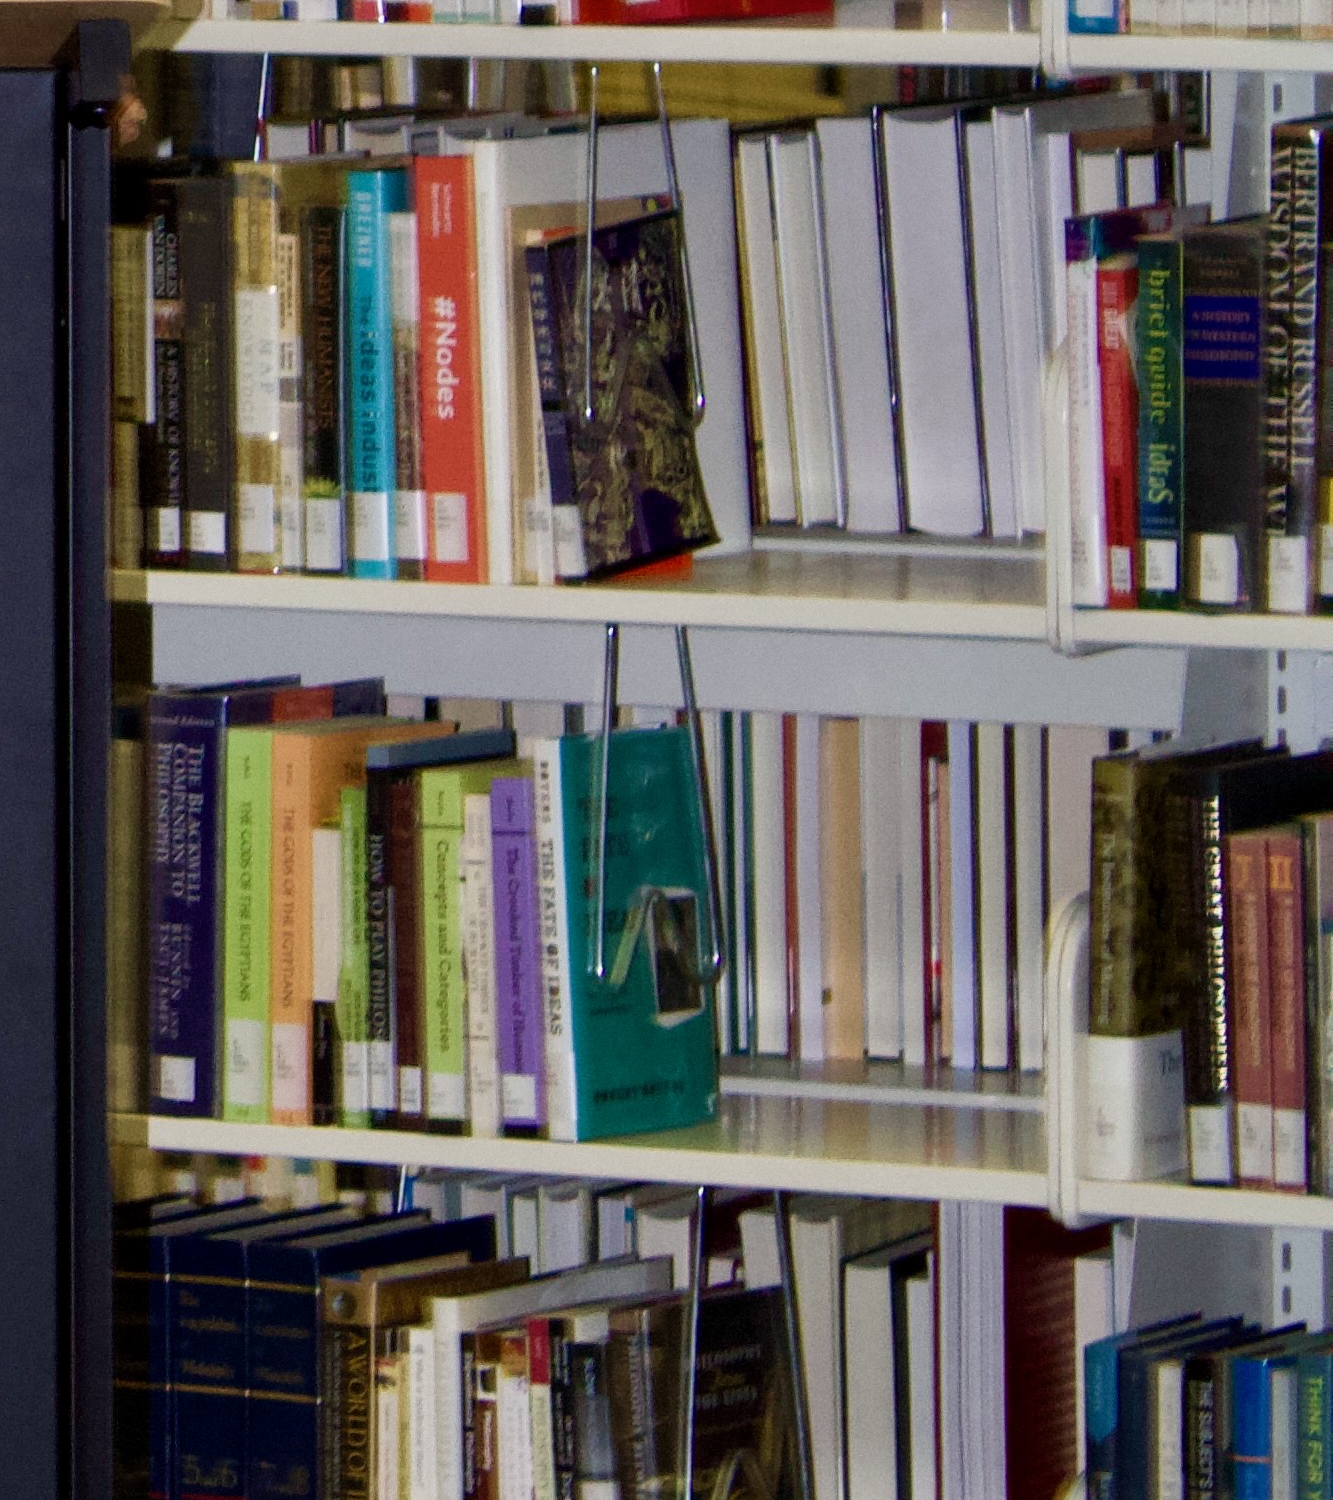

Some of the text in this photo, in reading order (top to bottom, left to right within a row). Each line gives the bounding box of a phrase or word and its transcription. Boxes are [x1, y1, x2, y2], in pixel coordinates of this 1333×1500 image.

[353, 190, 372, 269] DREZNER
[359, 330, 381, 401] ideas
[436, 295, 460, 420] #Nodes
[1143, 267, 1173, 425] brief guide
[1267, 145, 1293, 467] WISDOM OF THE
[1291, 145, 1316, 466] BERTRAND RUSSELL
[155, 742, 173, 864] PHILOSOPHY
[171, 742, 188, 898] COMPANION TO
[186, 743, 206, 906] THE BLACKWELL
[369, 834, 385, 884] HOW
[238, 800, 254, 1003] THE GODS OF THE EGYPTIANS
[282, 807, 296, 1008] THE GODS OF THE EGYPTIANS
[370, 889, 386, 917] TO
[371, 921, 387, 964] PLAY
[434, 840, 453, 1053] Concepts and Categories
[505, 847, 525, 1017] The Crooked Timber of
[540, 839, 565, 1036] THE FATE OF IDEAS
[345, 1352, 368, 1446] WORLD
[346, 1331, 367, 1351] A
[345, 1450, 368, 1480] OF
[1306, 1376, 1324, 1437] THINK
[1307, 1439, 1324, 1485] FOR
